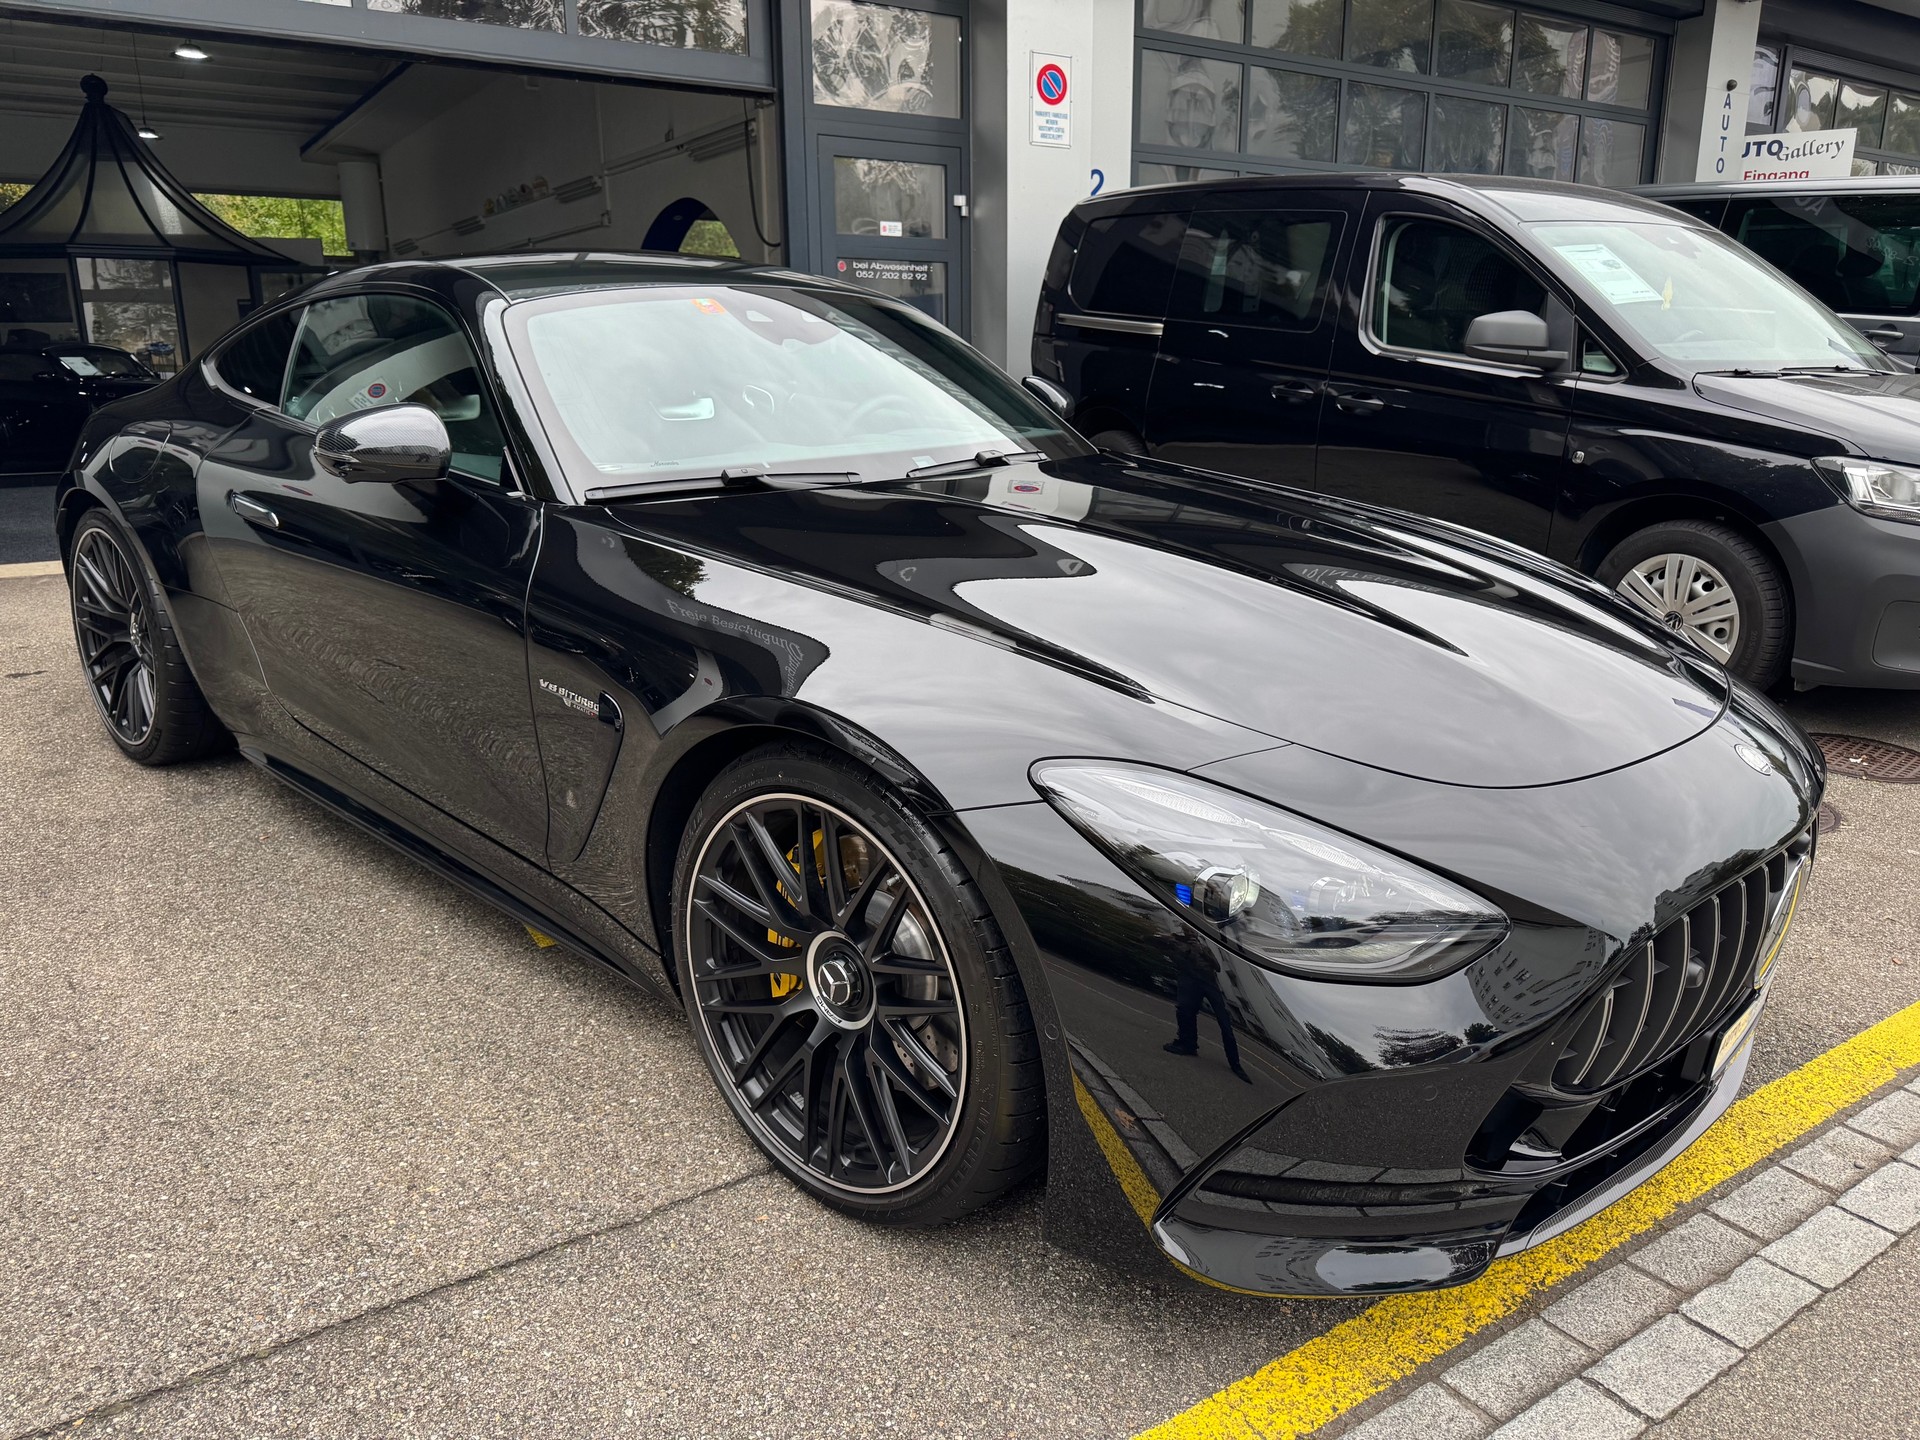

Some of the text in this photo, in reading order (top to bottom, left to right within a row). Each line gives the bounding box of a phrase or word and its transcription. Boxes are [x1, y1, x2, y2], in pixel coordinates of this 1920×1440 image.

[1716, 93, 1731, 173] AUTO
[1777, 139, 1845, 161] Gallery
[1091, 169, 1104, 196] 2
[870, 262, 928, 272] Abwesenheit
[667, 599, 707, 622] Freie
[539, 678, 599, 712] V8 BITURBO
